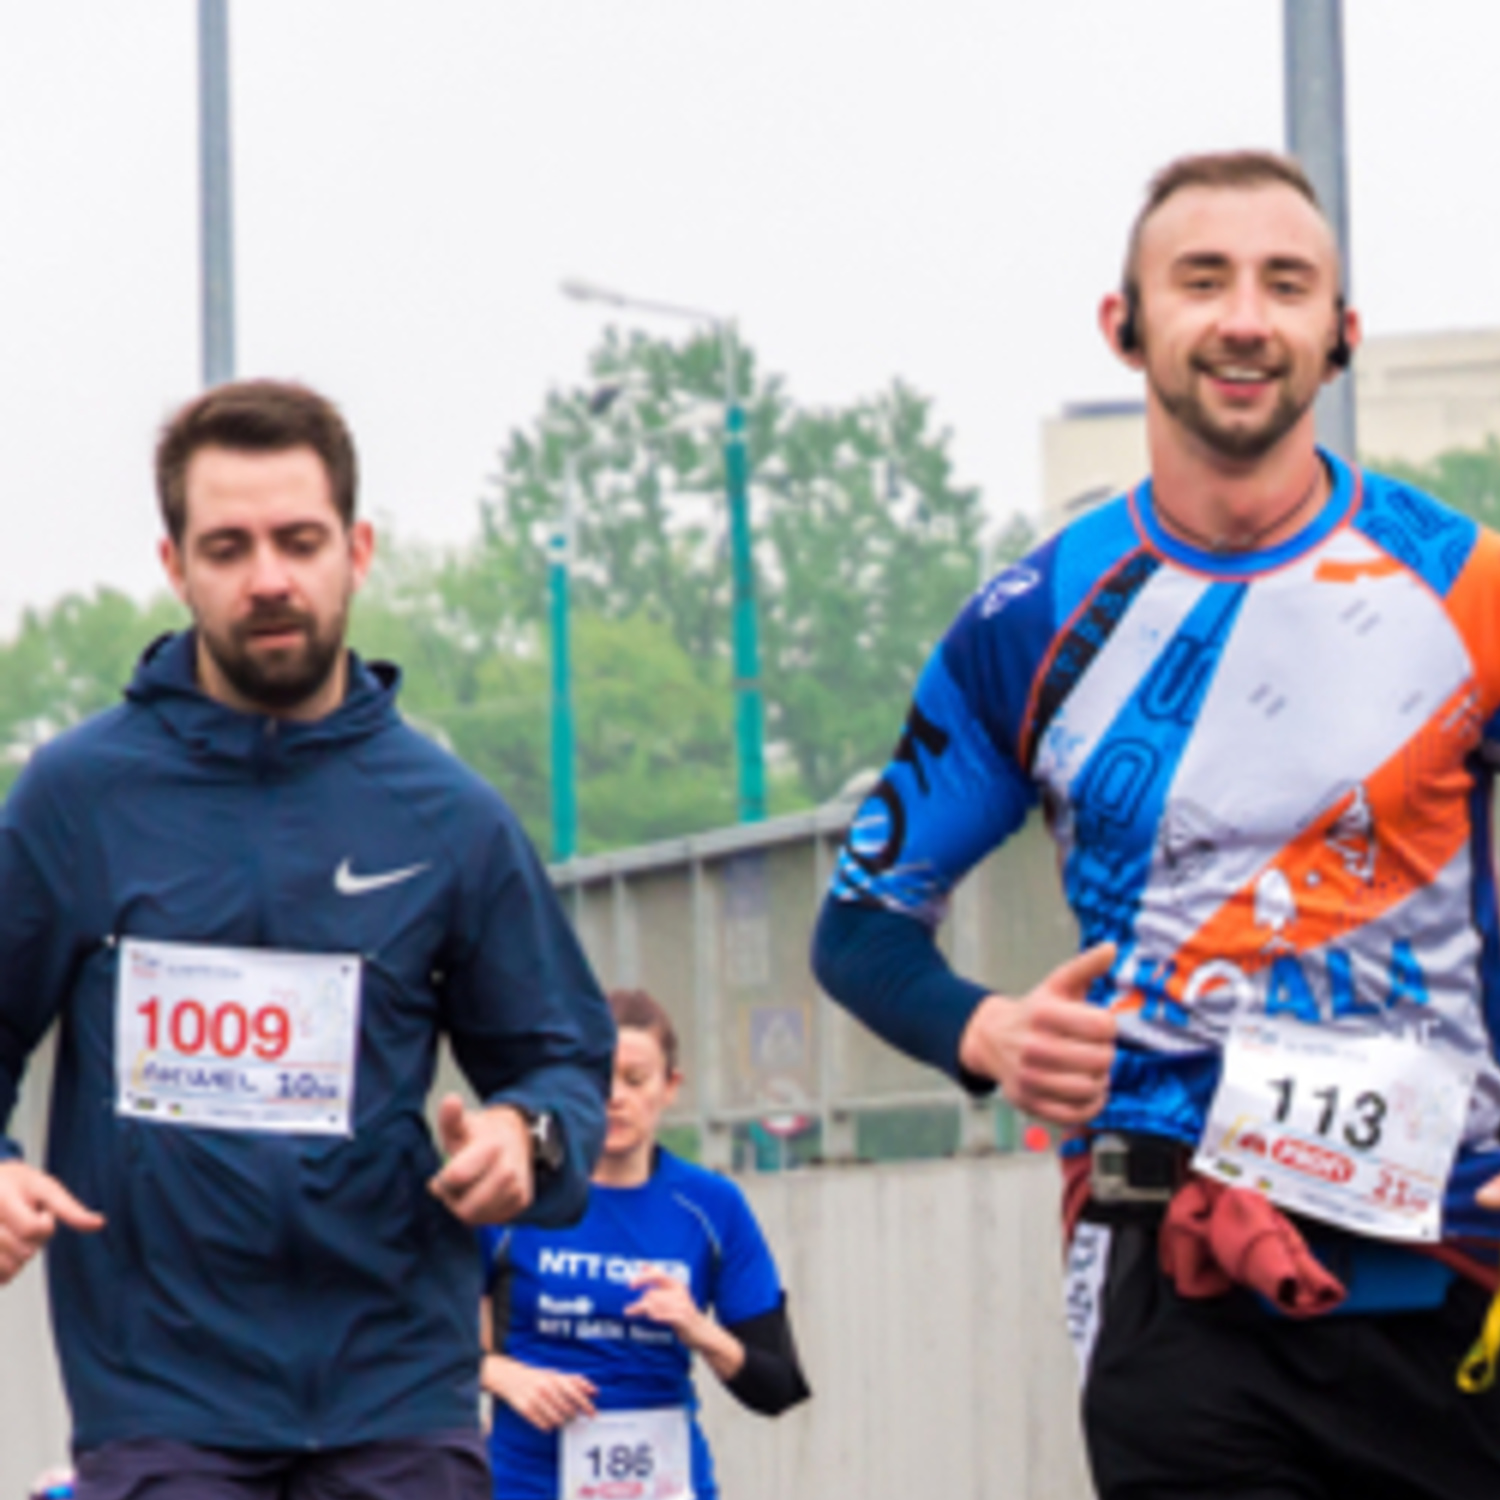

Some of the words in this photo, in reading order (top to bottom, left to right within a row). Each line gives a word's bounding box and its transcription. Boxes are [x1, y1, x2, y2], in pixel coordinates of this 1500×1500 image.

[137, 995, 293, 1062] 1009
[1267, 1073, 1388, 1152] 113
[538, 1247, 601, 1280] NTT
[585, 1442, 654, 1480] 186
